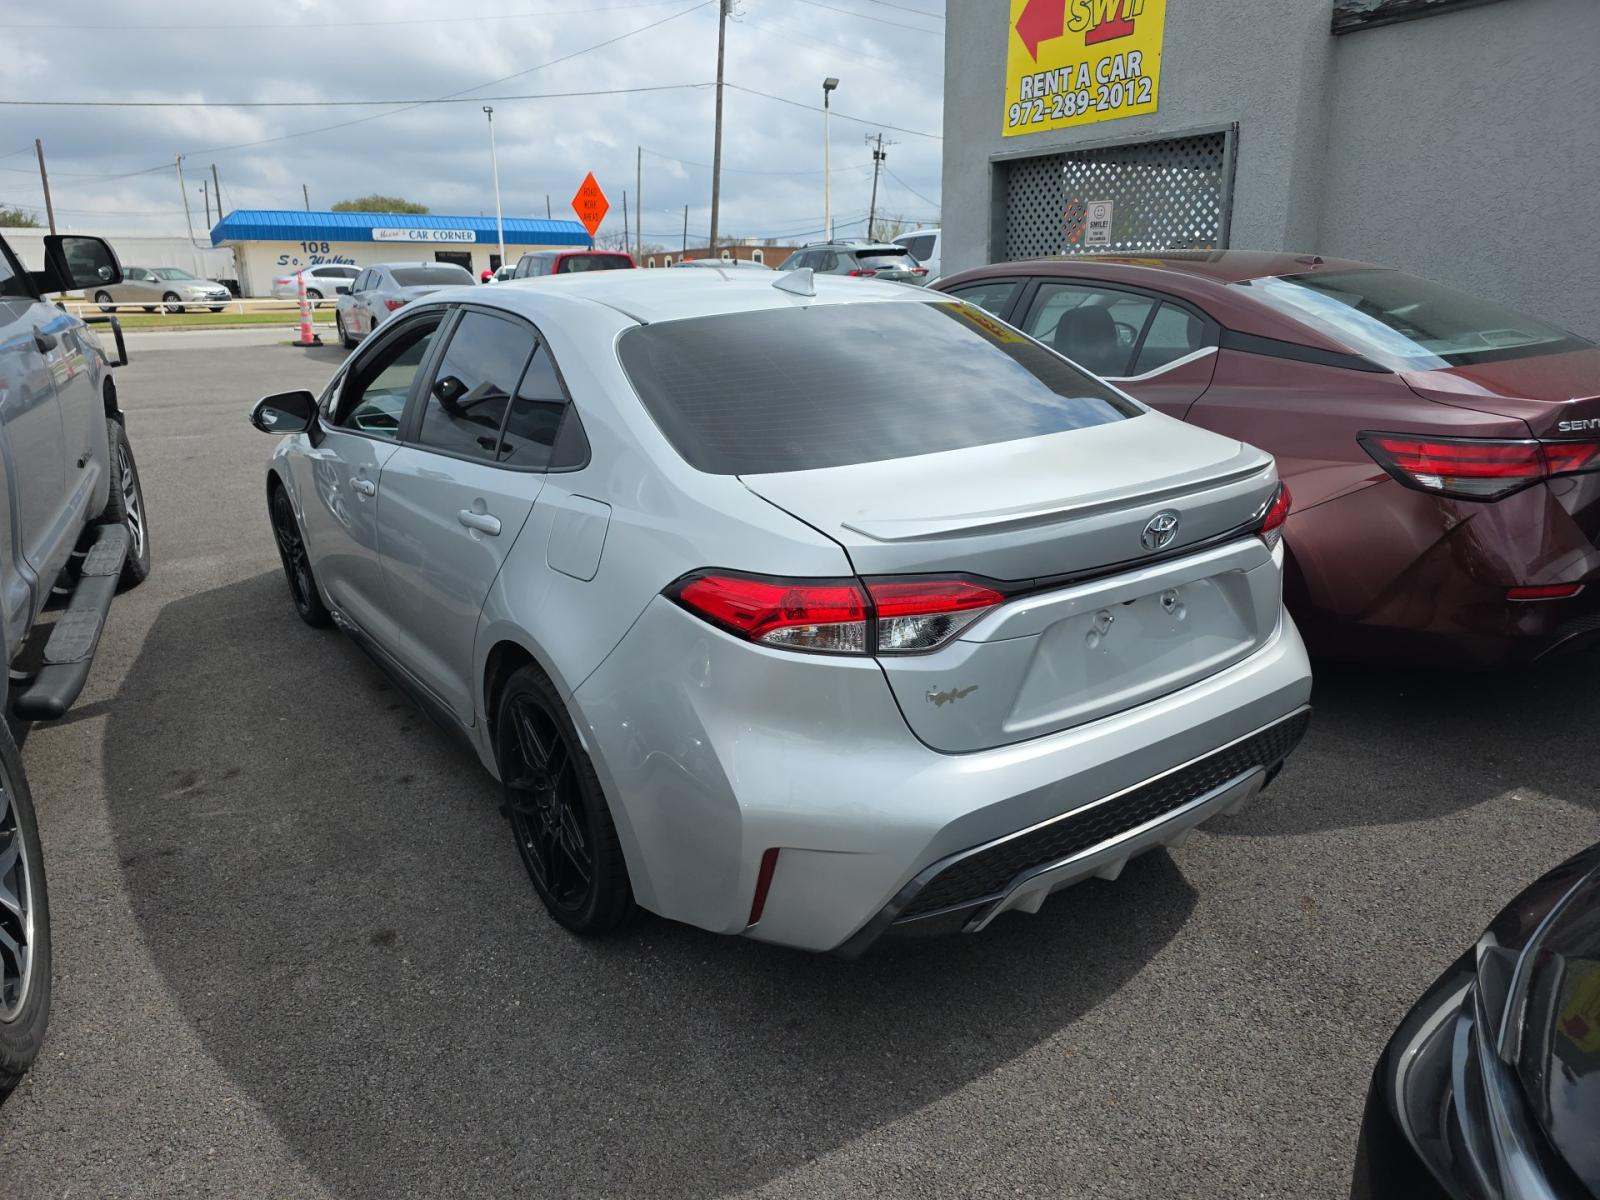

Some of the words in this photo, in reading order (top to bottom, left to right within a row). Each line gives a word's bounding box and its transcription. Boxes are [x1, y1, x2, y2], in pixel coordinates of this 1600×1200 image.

[1020, 65, 1073, 101] RENT
[1075, 62, 1091, 90] A
[1096, 50, 1143, 84] CAR
[1008, 76, 1152, 127] 972-289-2012
[300, 241, 330, 254] 108
[408, 230, 429, 240] CAR
[433, 230, 473, 240] CORNER
